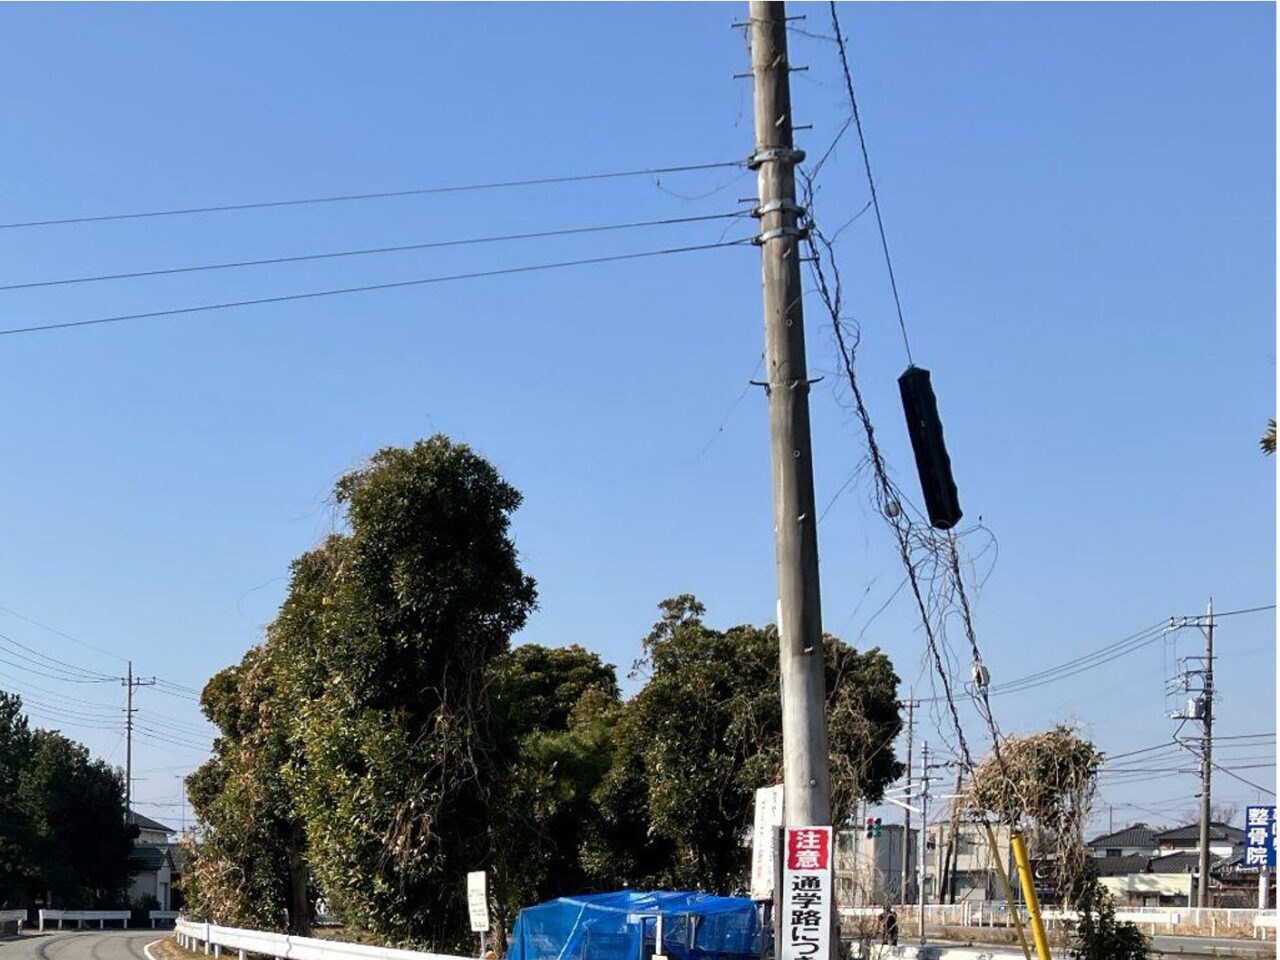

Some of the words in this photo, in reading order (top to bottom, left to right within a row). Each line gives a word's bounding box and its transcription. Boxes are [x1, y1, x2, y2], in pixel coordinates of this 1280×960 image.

[796, 831, 821, 868] 注意
[1246, 808, 1269, 865] 整骨院
